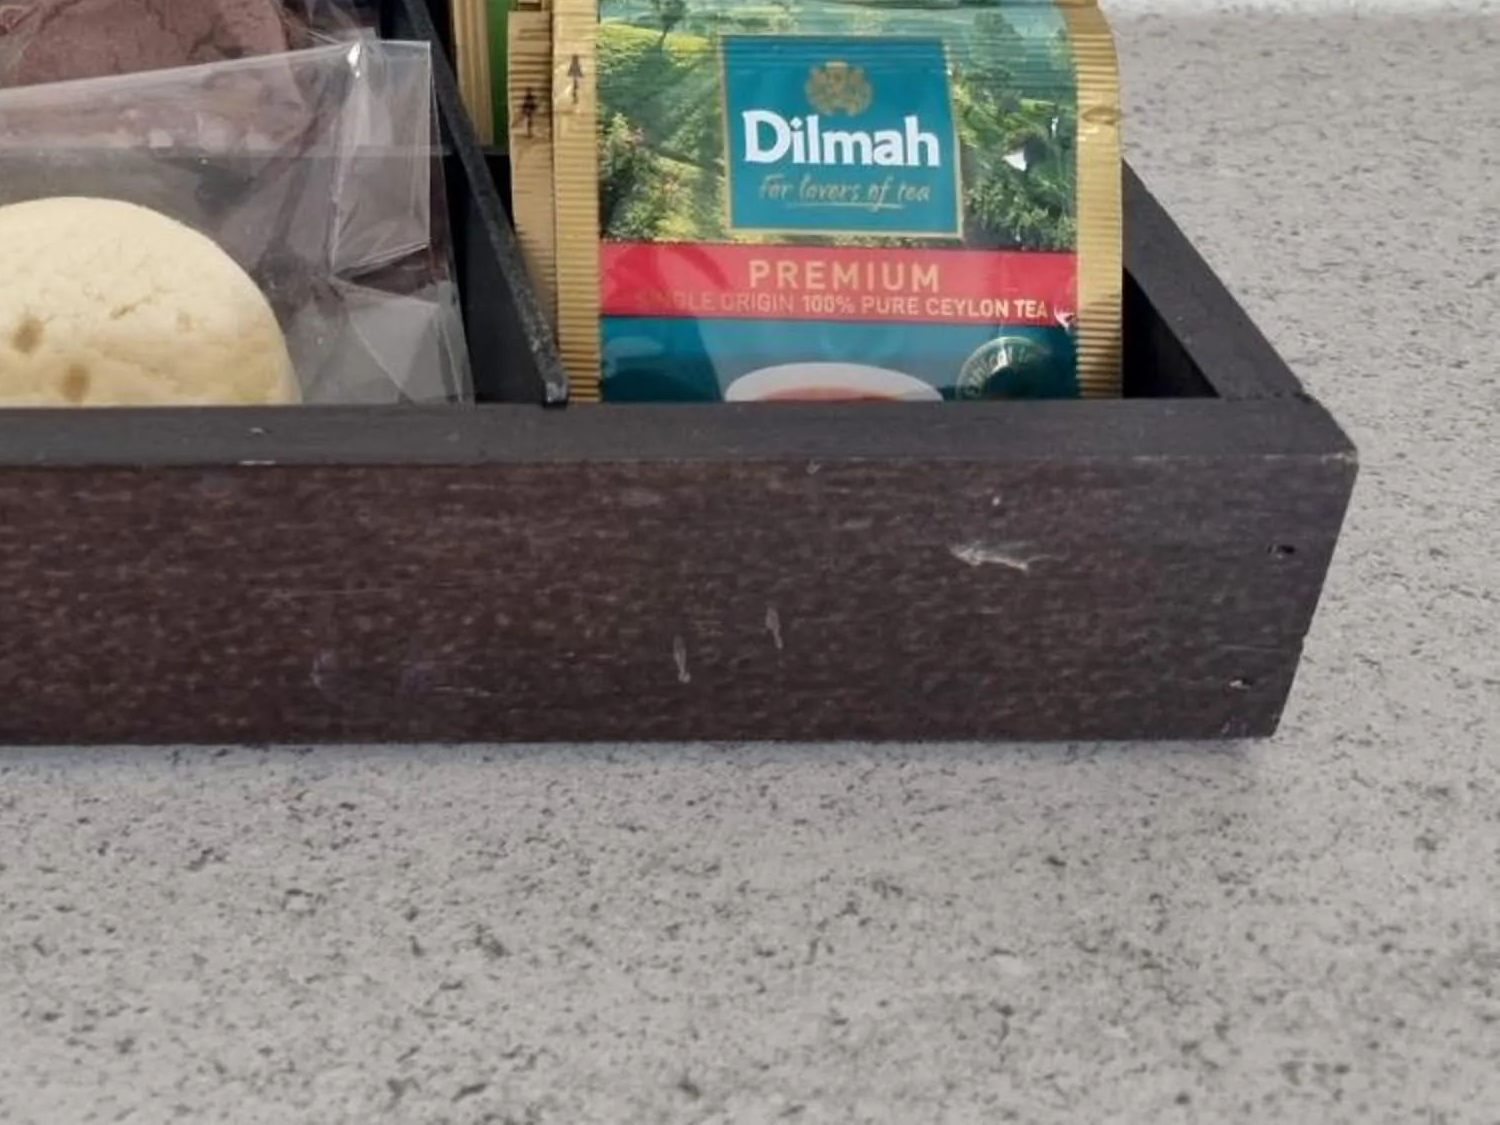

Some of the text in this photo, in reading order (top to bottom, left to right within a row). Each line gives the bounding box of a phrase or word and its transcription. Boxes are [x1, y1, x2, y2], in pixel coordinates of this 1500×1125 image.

[742, 110, 940, 167] Dilmah
[760, 174, 930, 212] For lovers of tea
[749, 260, 940, 293] PREMIUM
[720, 291, 794, 313] ORIGIN
[802, 295, 855, 314] 100%
[861, 295, 920, 315] PURE
[925, 297, 1009, 317] CEYLON
[1013, 299, 1048, 318] TEA
